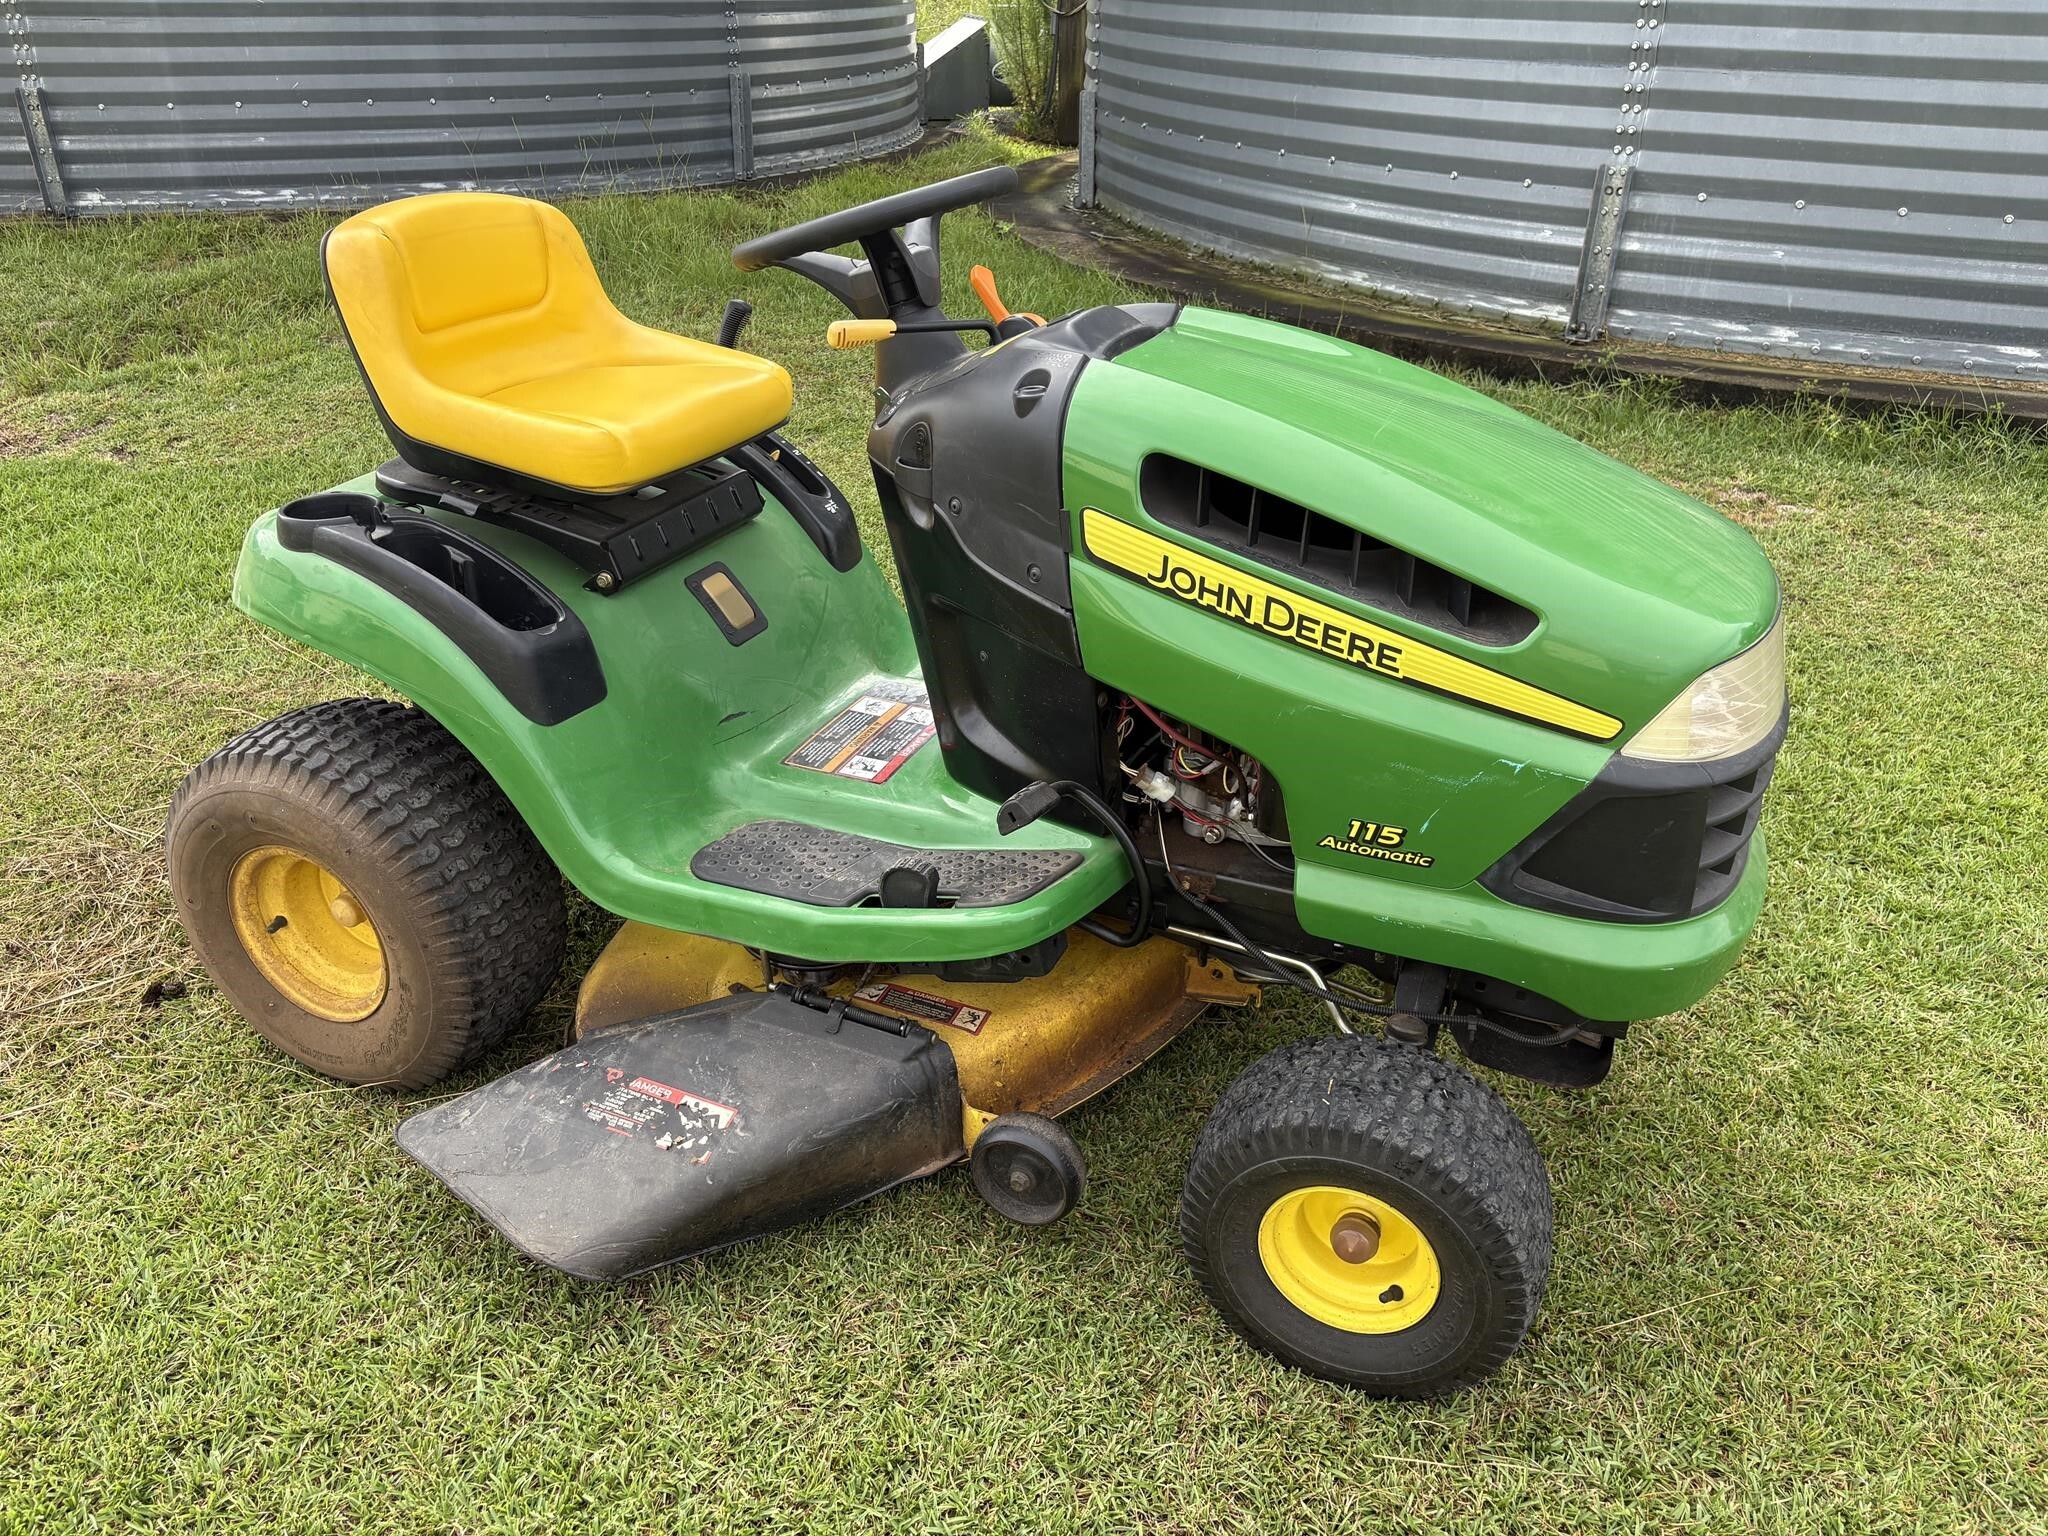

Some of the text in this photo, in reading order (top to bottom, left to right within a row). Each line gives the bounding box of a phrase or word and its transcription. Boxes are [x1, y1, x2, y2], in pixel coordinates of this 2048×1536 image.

[1147, 555, 1404, 674] JOHN DEERE
[1348, 820, 1405, 846] 115
[1319, 836, 1432, 866] Automatic
